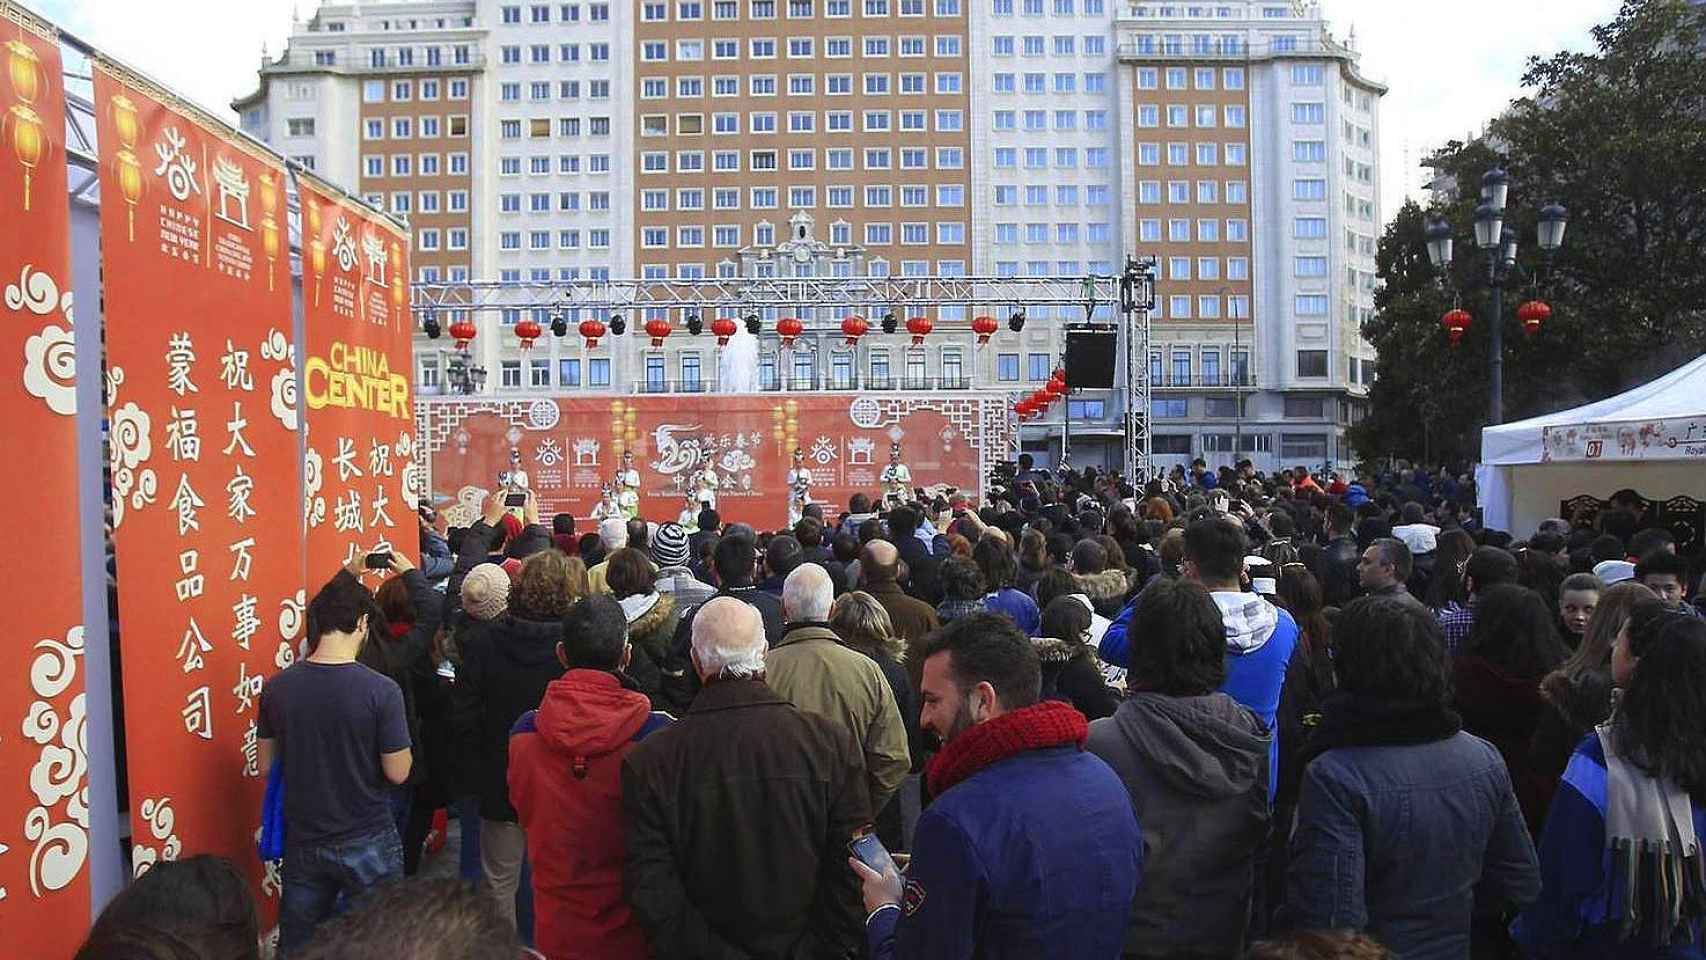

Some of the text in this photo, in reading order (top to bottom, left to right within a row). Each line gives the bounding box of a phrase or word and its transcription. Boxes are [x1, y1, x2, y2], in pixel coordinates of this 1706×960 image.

[304, 356, 411, 420] CENTER
[330, 341, 390, 379] CHINA
[1587, 442, 1602, 457] 01
[165, 331, 214, 740] 蒙福食品公司
[219, 338, 263, 778] 祝大家万事如意
